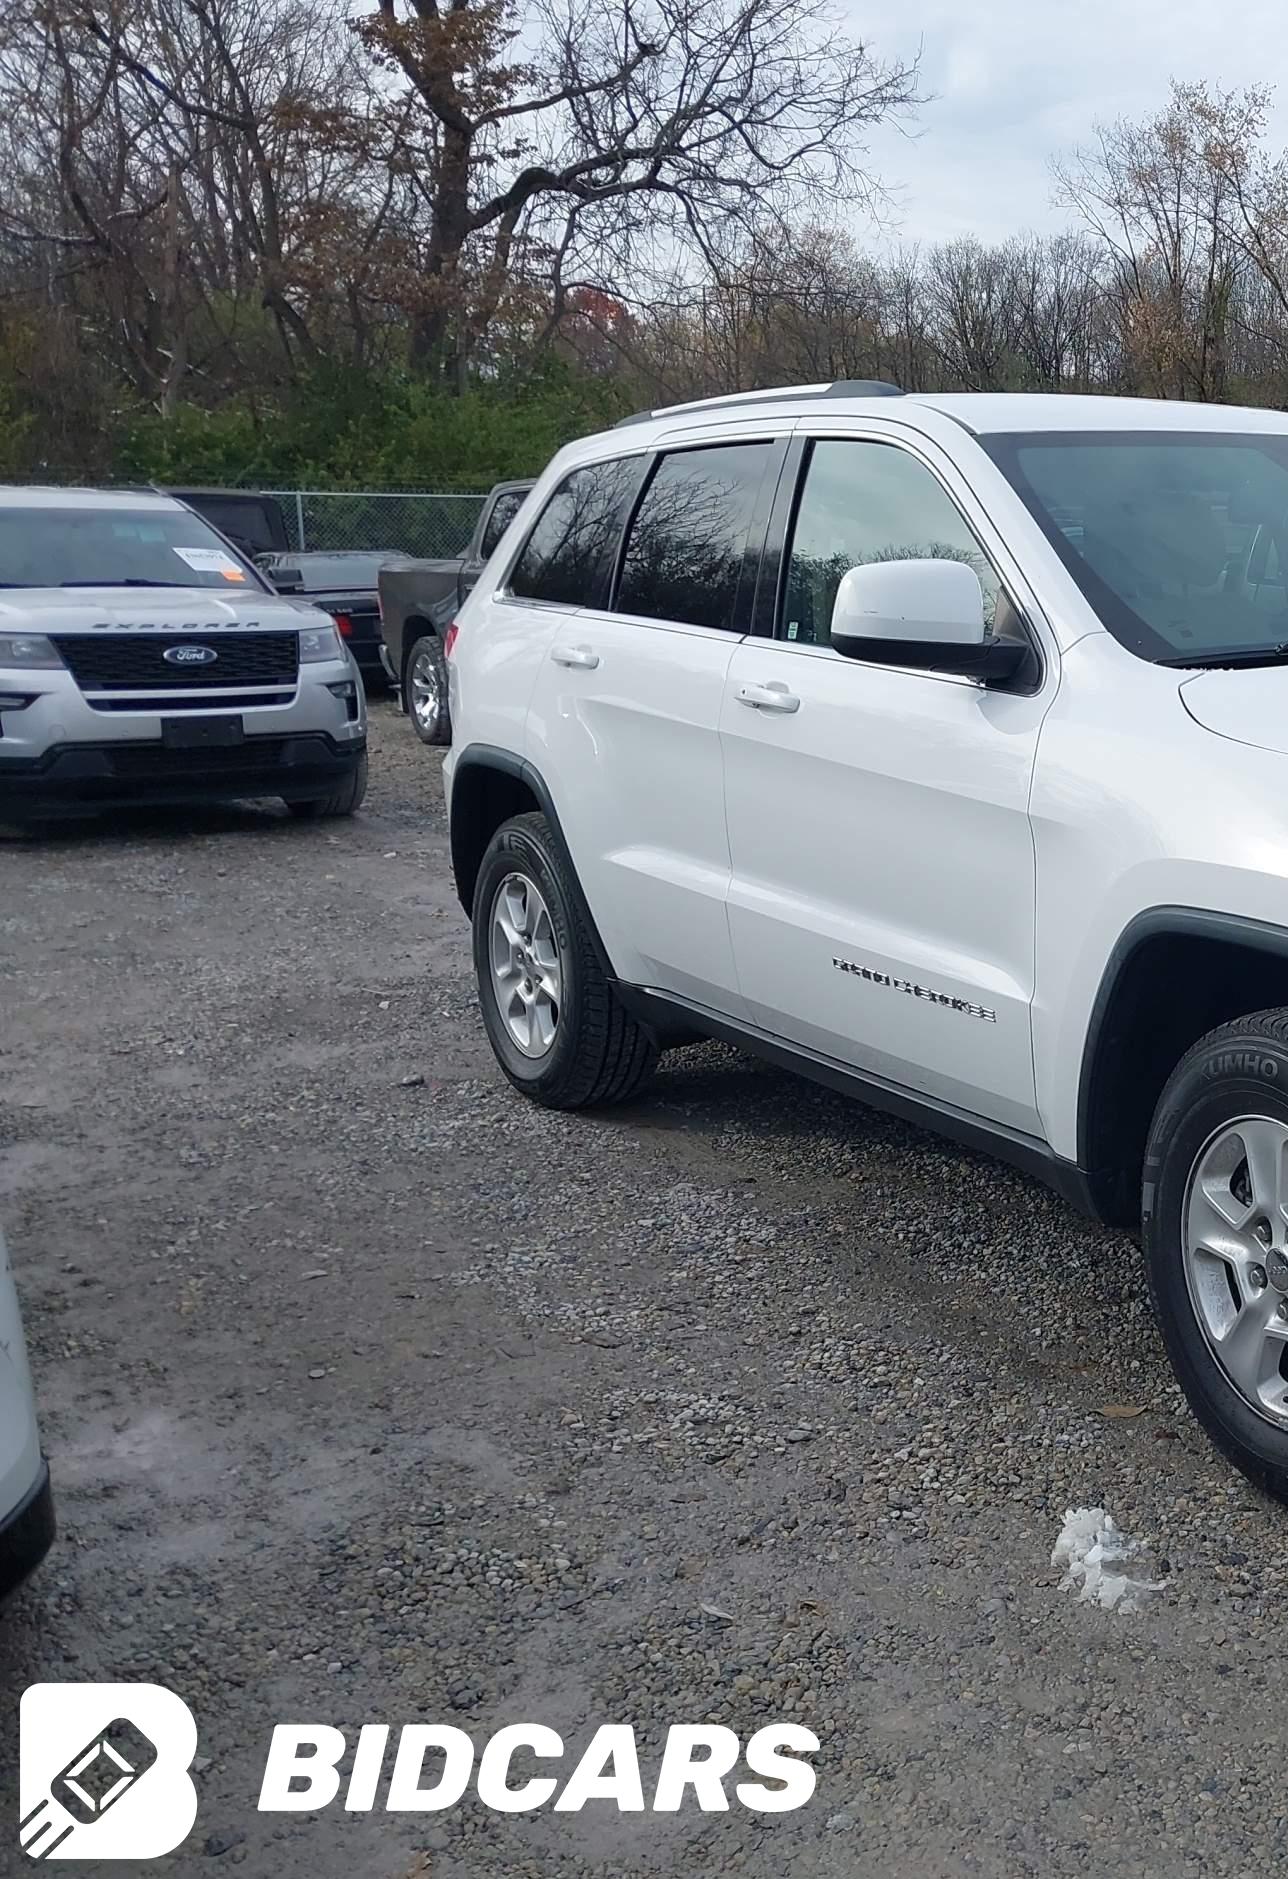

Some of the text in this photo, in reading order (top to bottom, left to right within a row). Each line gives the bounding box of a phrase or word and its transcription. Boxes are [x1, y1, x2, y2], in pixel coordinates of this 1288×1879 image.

[92, 621, 260, 630] EXPLORER
[176, 648, 205, 661] Ford
[893, 977, 997, 1023] CHEROKEE
[1200, 1053, 1279, 1080] KUMHO
